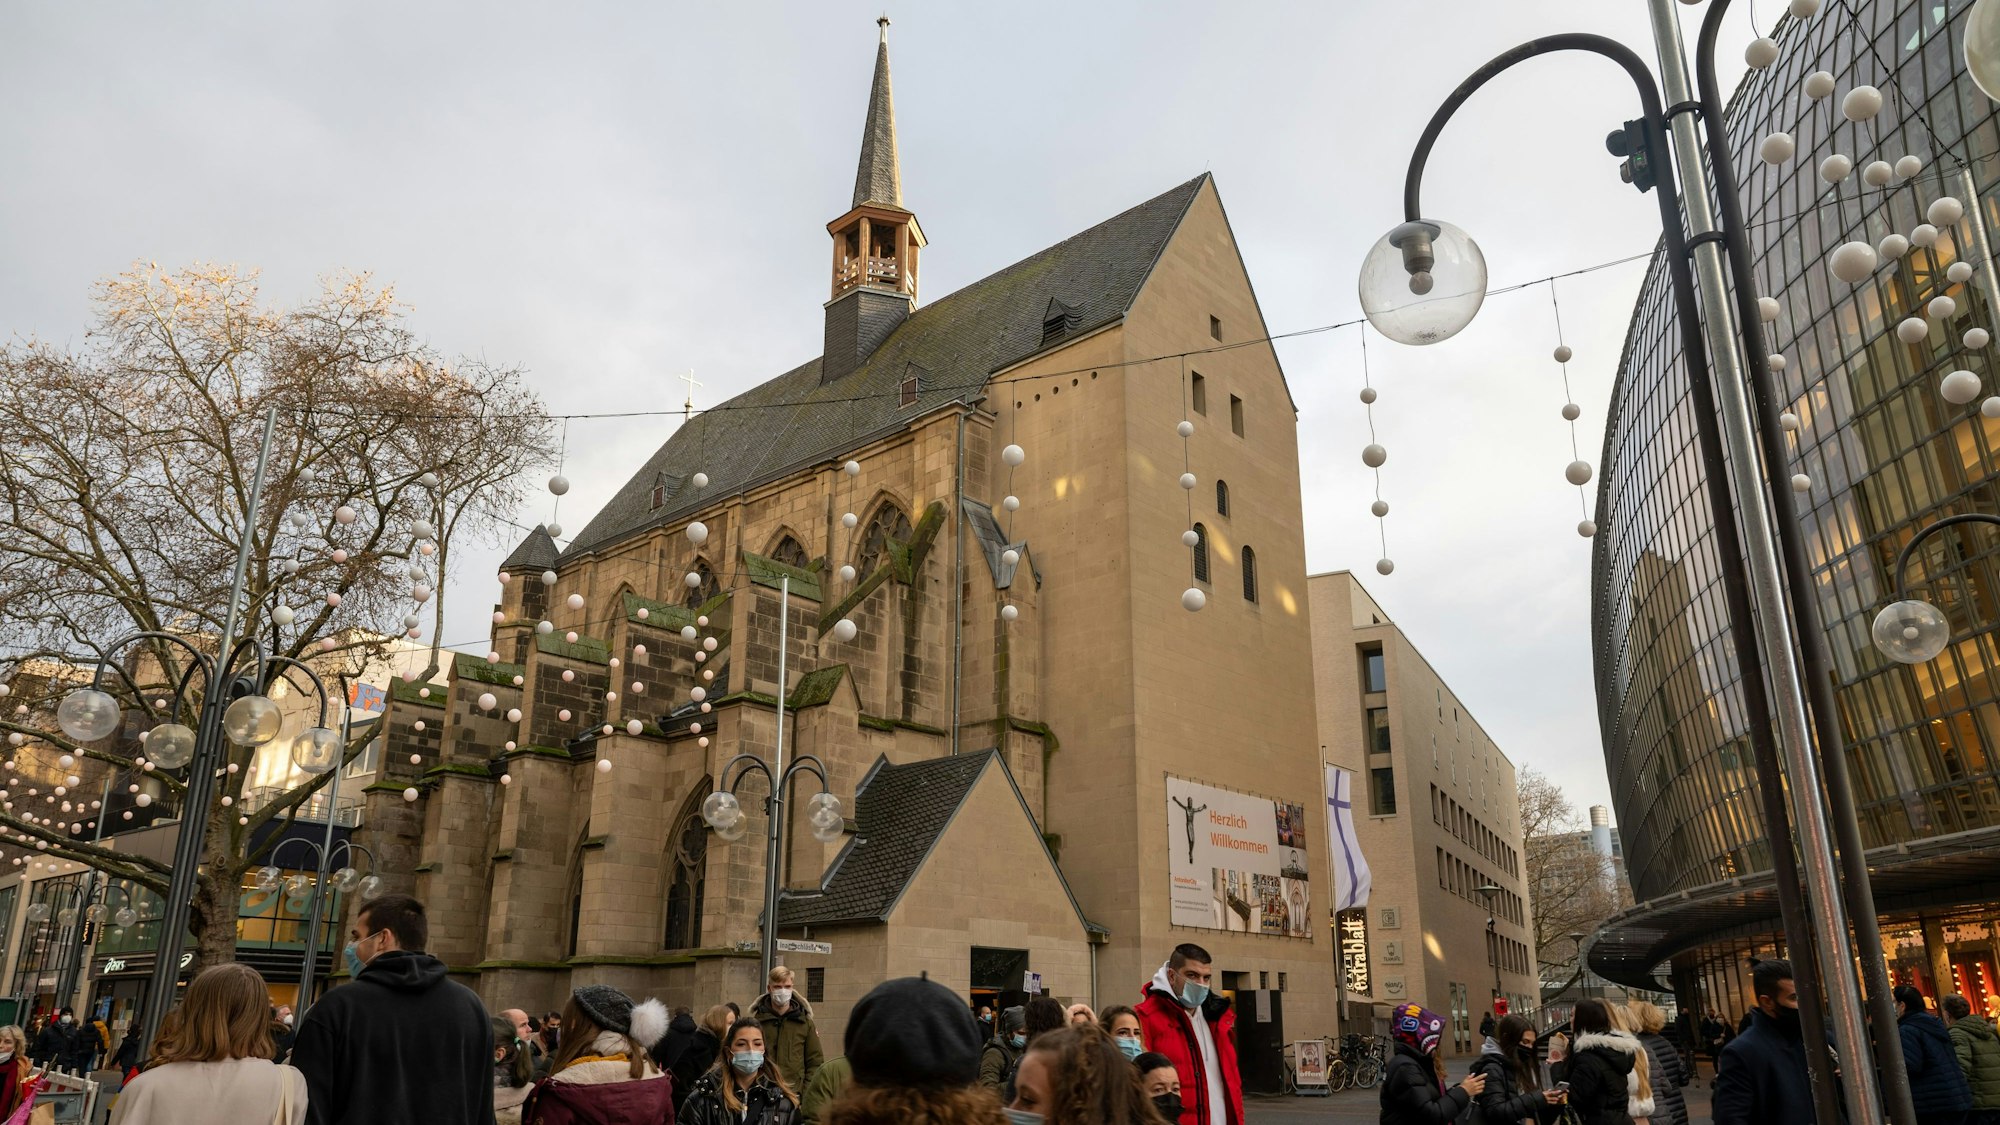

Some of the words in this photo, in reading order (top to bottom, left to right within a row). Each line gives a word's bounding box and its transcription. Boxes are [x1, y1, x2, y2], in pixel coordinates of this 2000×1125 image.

[1210, 810, 1247, 829] Herzlich
[1211, 832, 1268, 854] Willkommen
[1342, 917, 1368, 991] extrablatt
